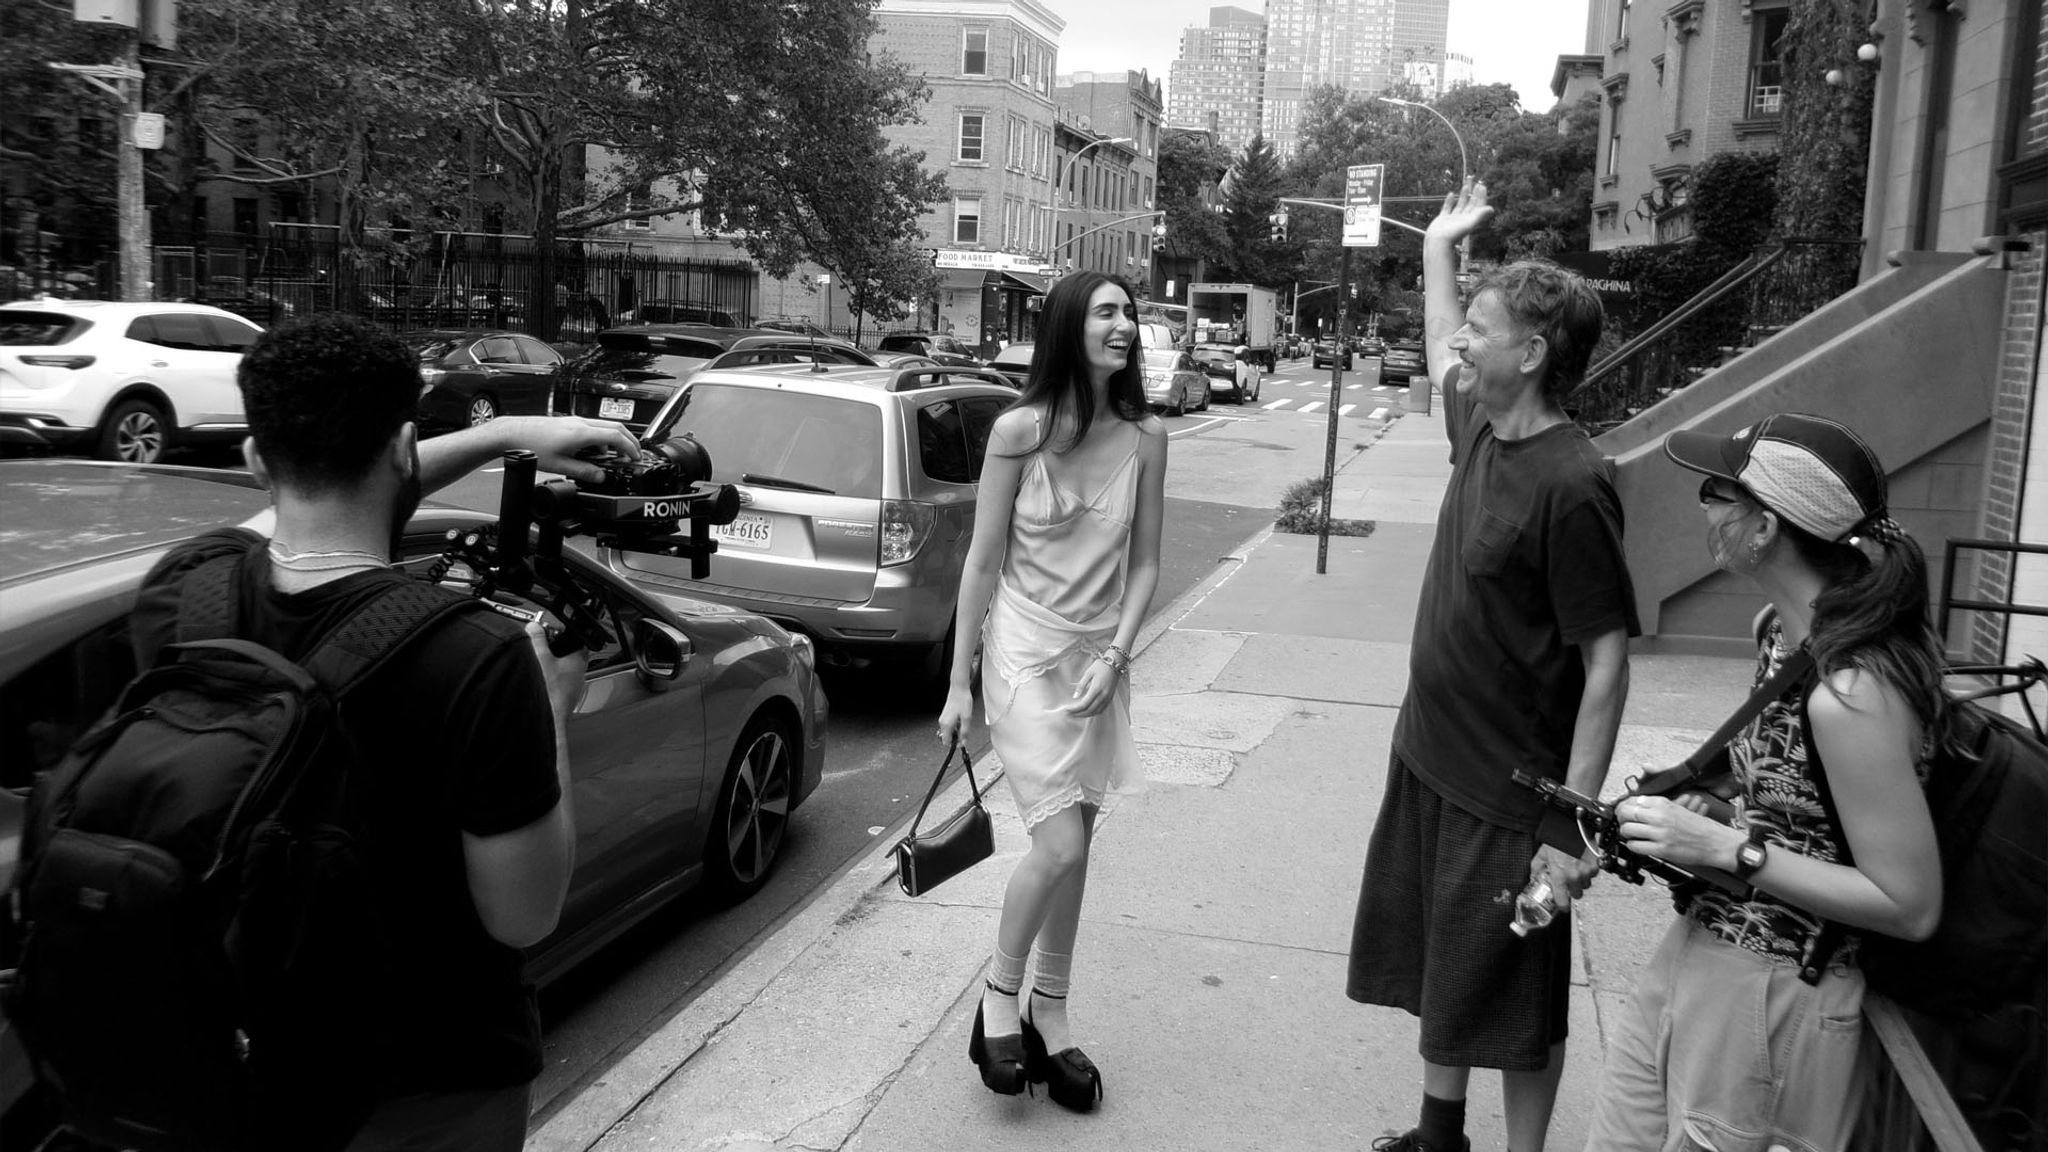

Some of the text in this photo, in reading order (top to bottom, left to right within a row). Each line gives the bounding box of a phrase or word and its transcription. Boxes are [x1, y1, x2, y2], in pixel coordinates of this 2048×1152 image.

[938, 253, 958, 261] FOOD
[960, 254, 993, 263] MARKET
[1583, 278, 1631, 293] RAGHINA
[644, 500, 691, 517] RONIN
